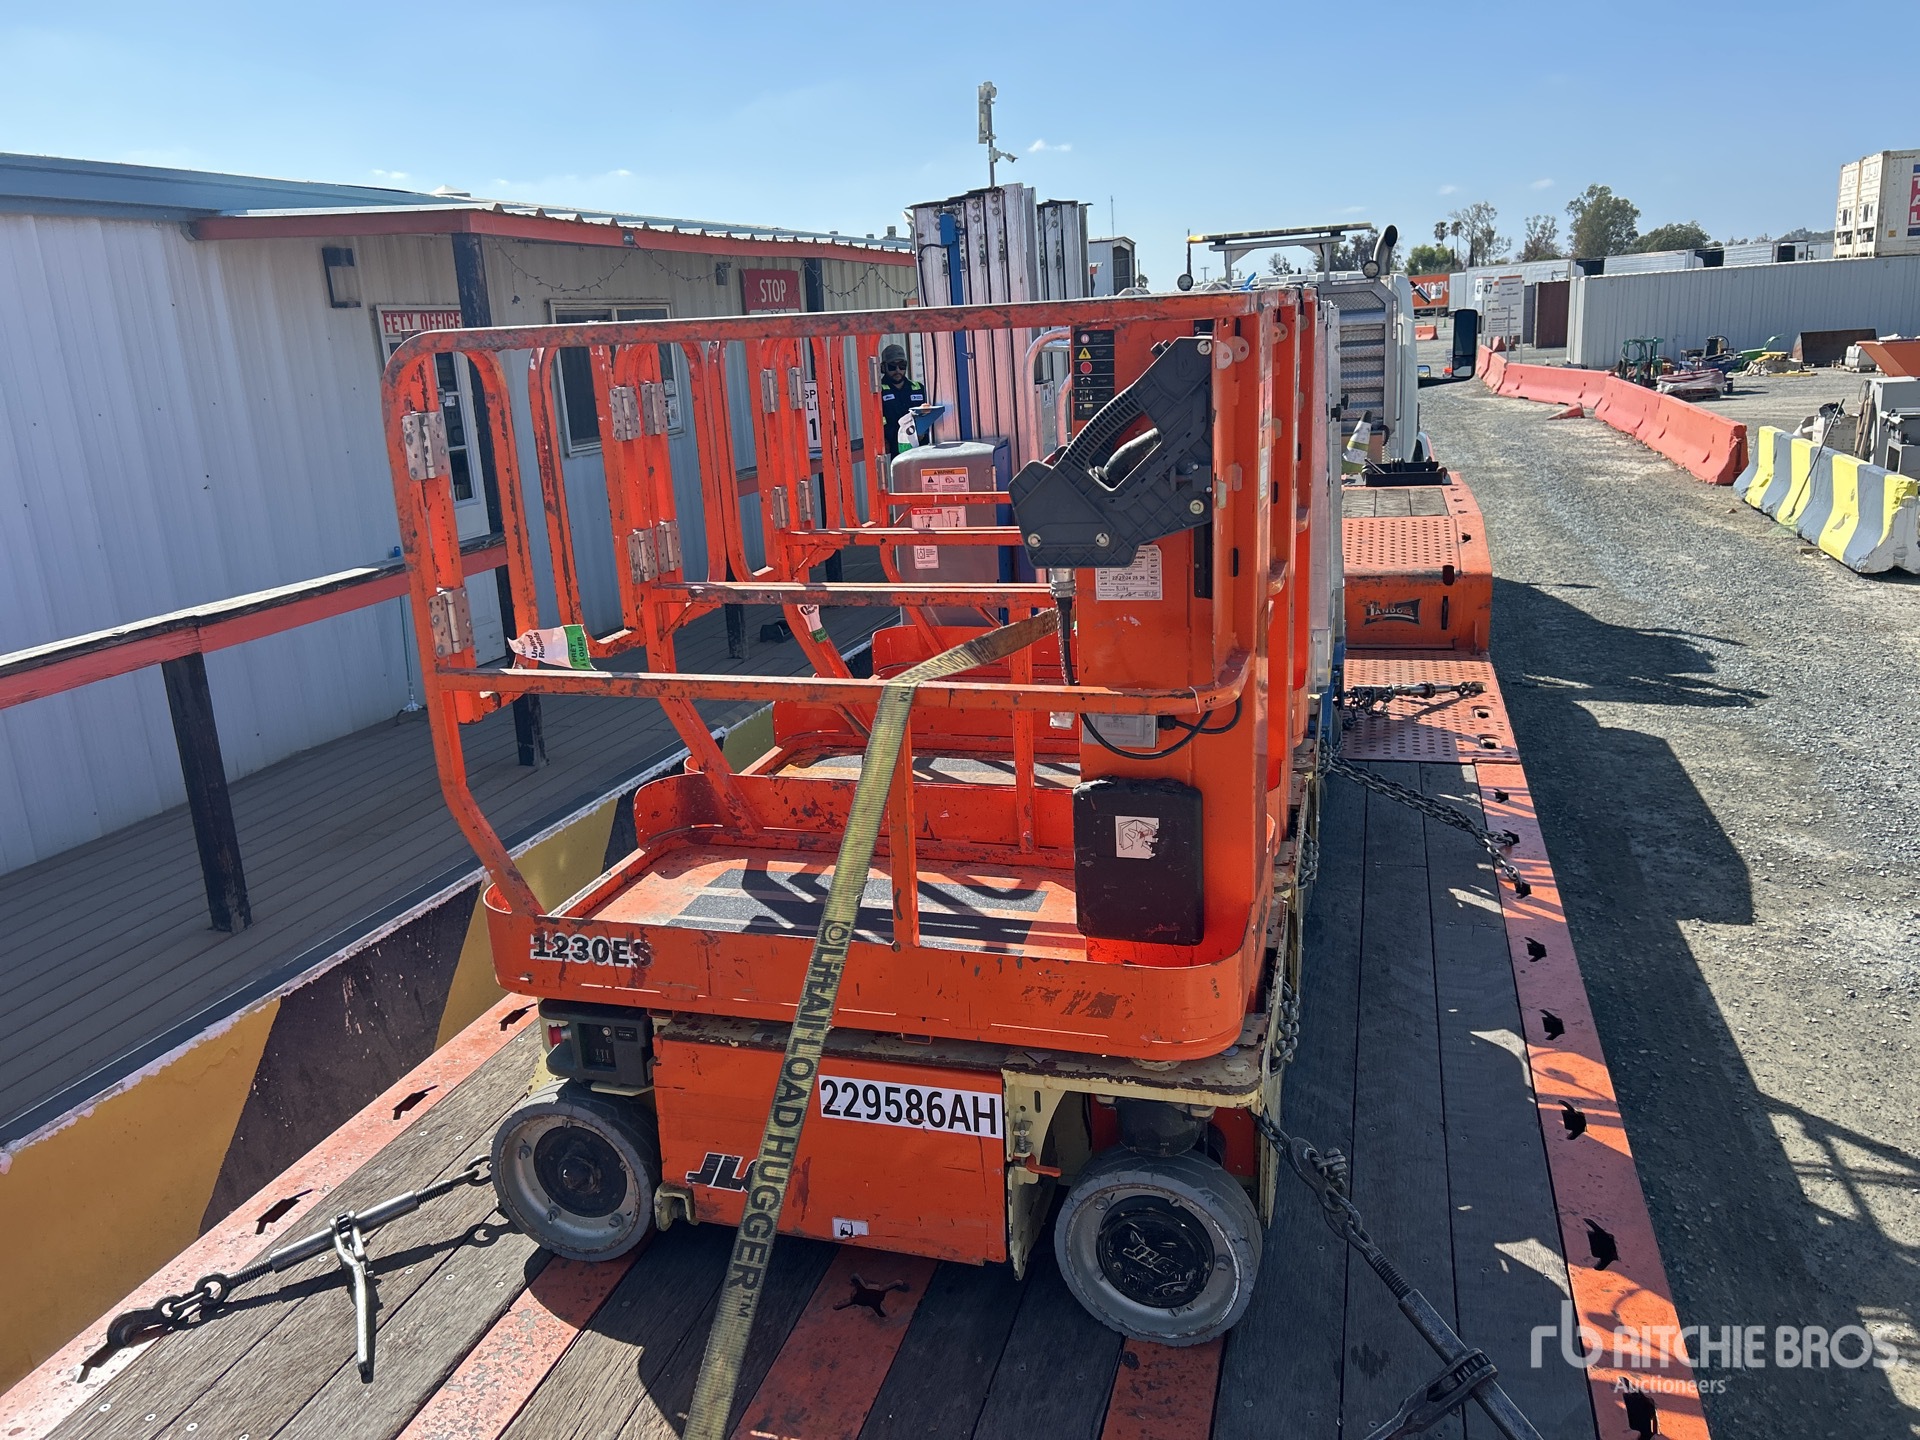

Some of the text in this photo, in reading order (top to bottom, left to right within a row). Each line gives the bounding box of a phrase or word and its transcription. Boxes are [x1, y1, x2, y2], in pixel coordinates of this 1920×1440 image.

[760, 278, 787, 303] STOP
[1483, 284, 1493, 295] 47
[383, 311, 461, 334] FETY OFFICE
[526, 634, 538, 659] United
[534, 632, 545, 659] Rentals
[532, 934, 653, 968] 1230ES
[773, 1037, 821, 1129] LOAD
[820, 1079, 997, 1135] 229586AH
[686, 1152, 755, 1192] JL
[727, 1133, 796, 1289] HUGGER
